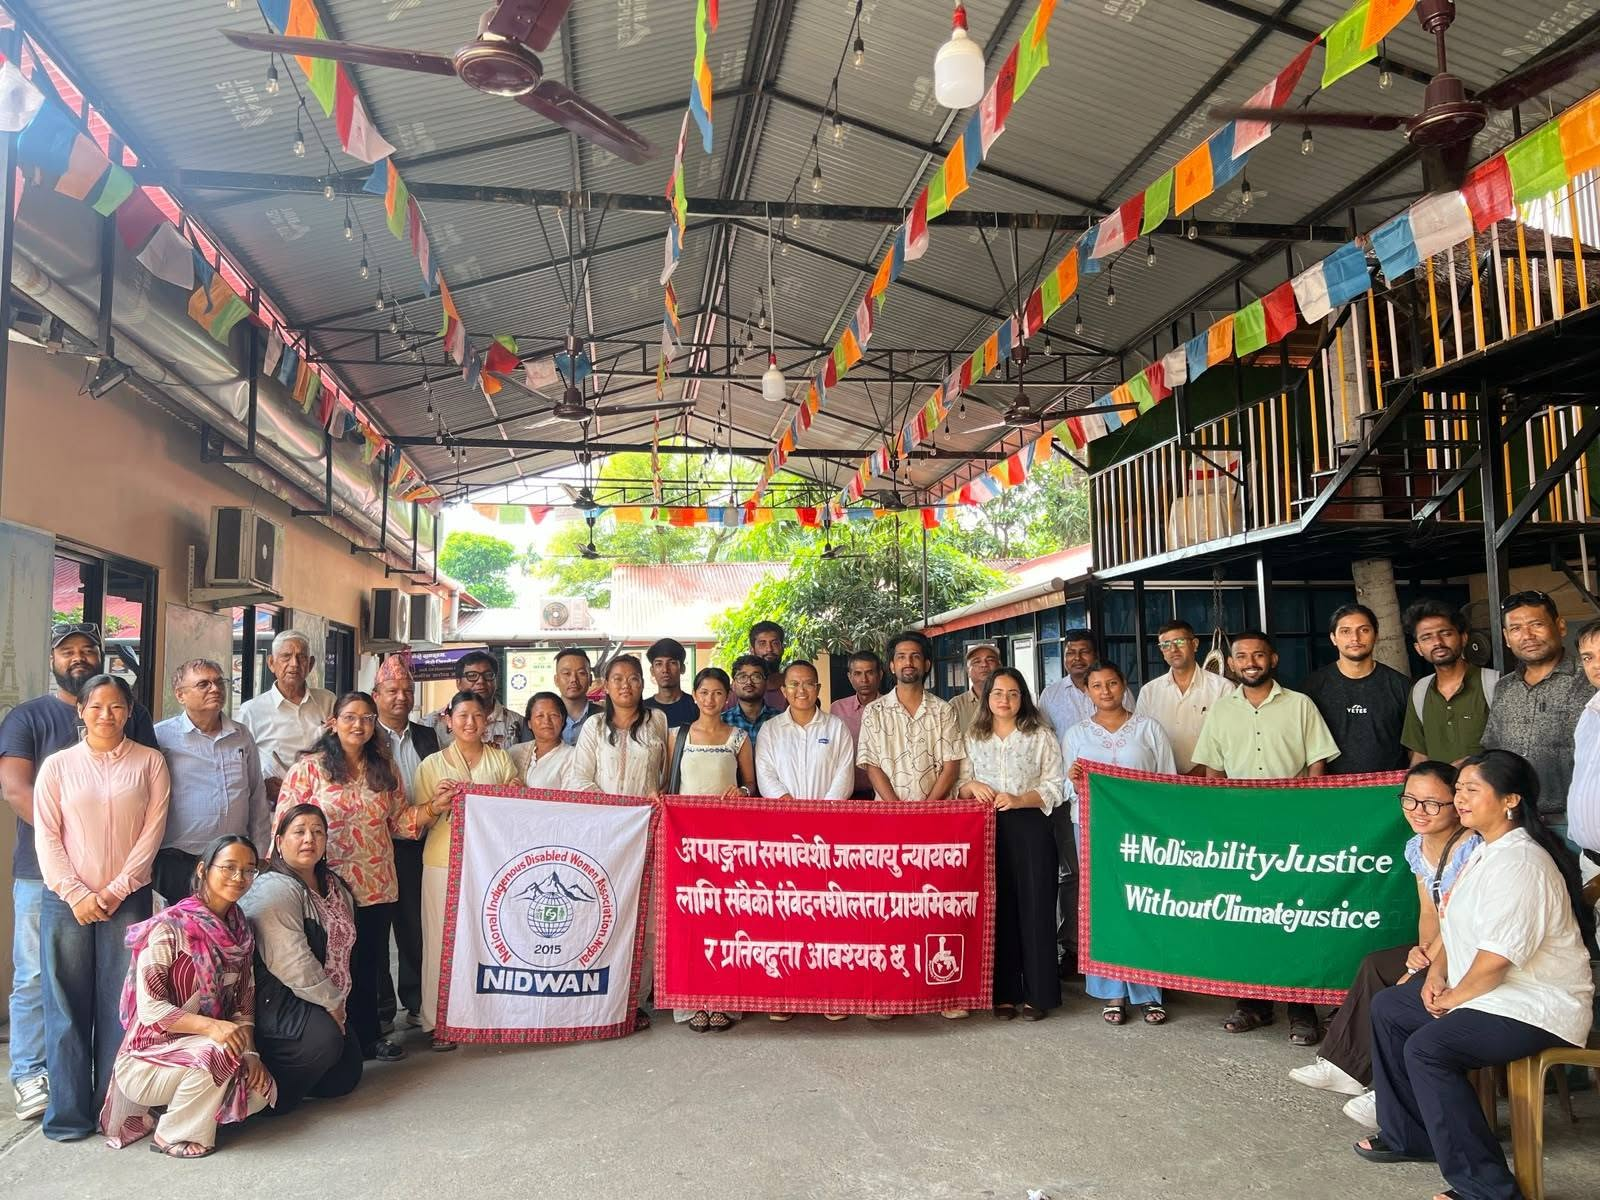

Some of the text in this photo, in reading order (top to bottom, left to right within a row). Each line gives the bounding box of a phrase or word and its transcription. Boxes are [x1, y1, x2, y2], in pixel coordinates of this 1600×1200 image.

[525, 850, 568, 866] Disabled
[570, 853, 599, 881] Women
[758, 834, 831, 870] समावेशी
[833, 843, 903, 878] जलवायु
[901, 843, 971, 871] न्यायका
[1120, 833, 1393, 881] #NoDisabilityJustice
[487, 861, 526, 911] Indigenous
[675, 878, 722, 915] लागि
[888, 884, 979, 919] प्राथमिकता
[1125, 884, 1381, 933] WithoutClimatejustice
[486, 913, 511, 963] National
[534, 944, 562, 955] 2015
[703, 938, 718, 972] र
[804, 943, 887, 973] आवश्यक
[482, 968, 600, 993] NIDWAN
